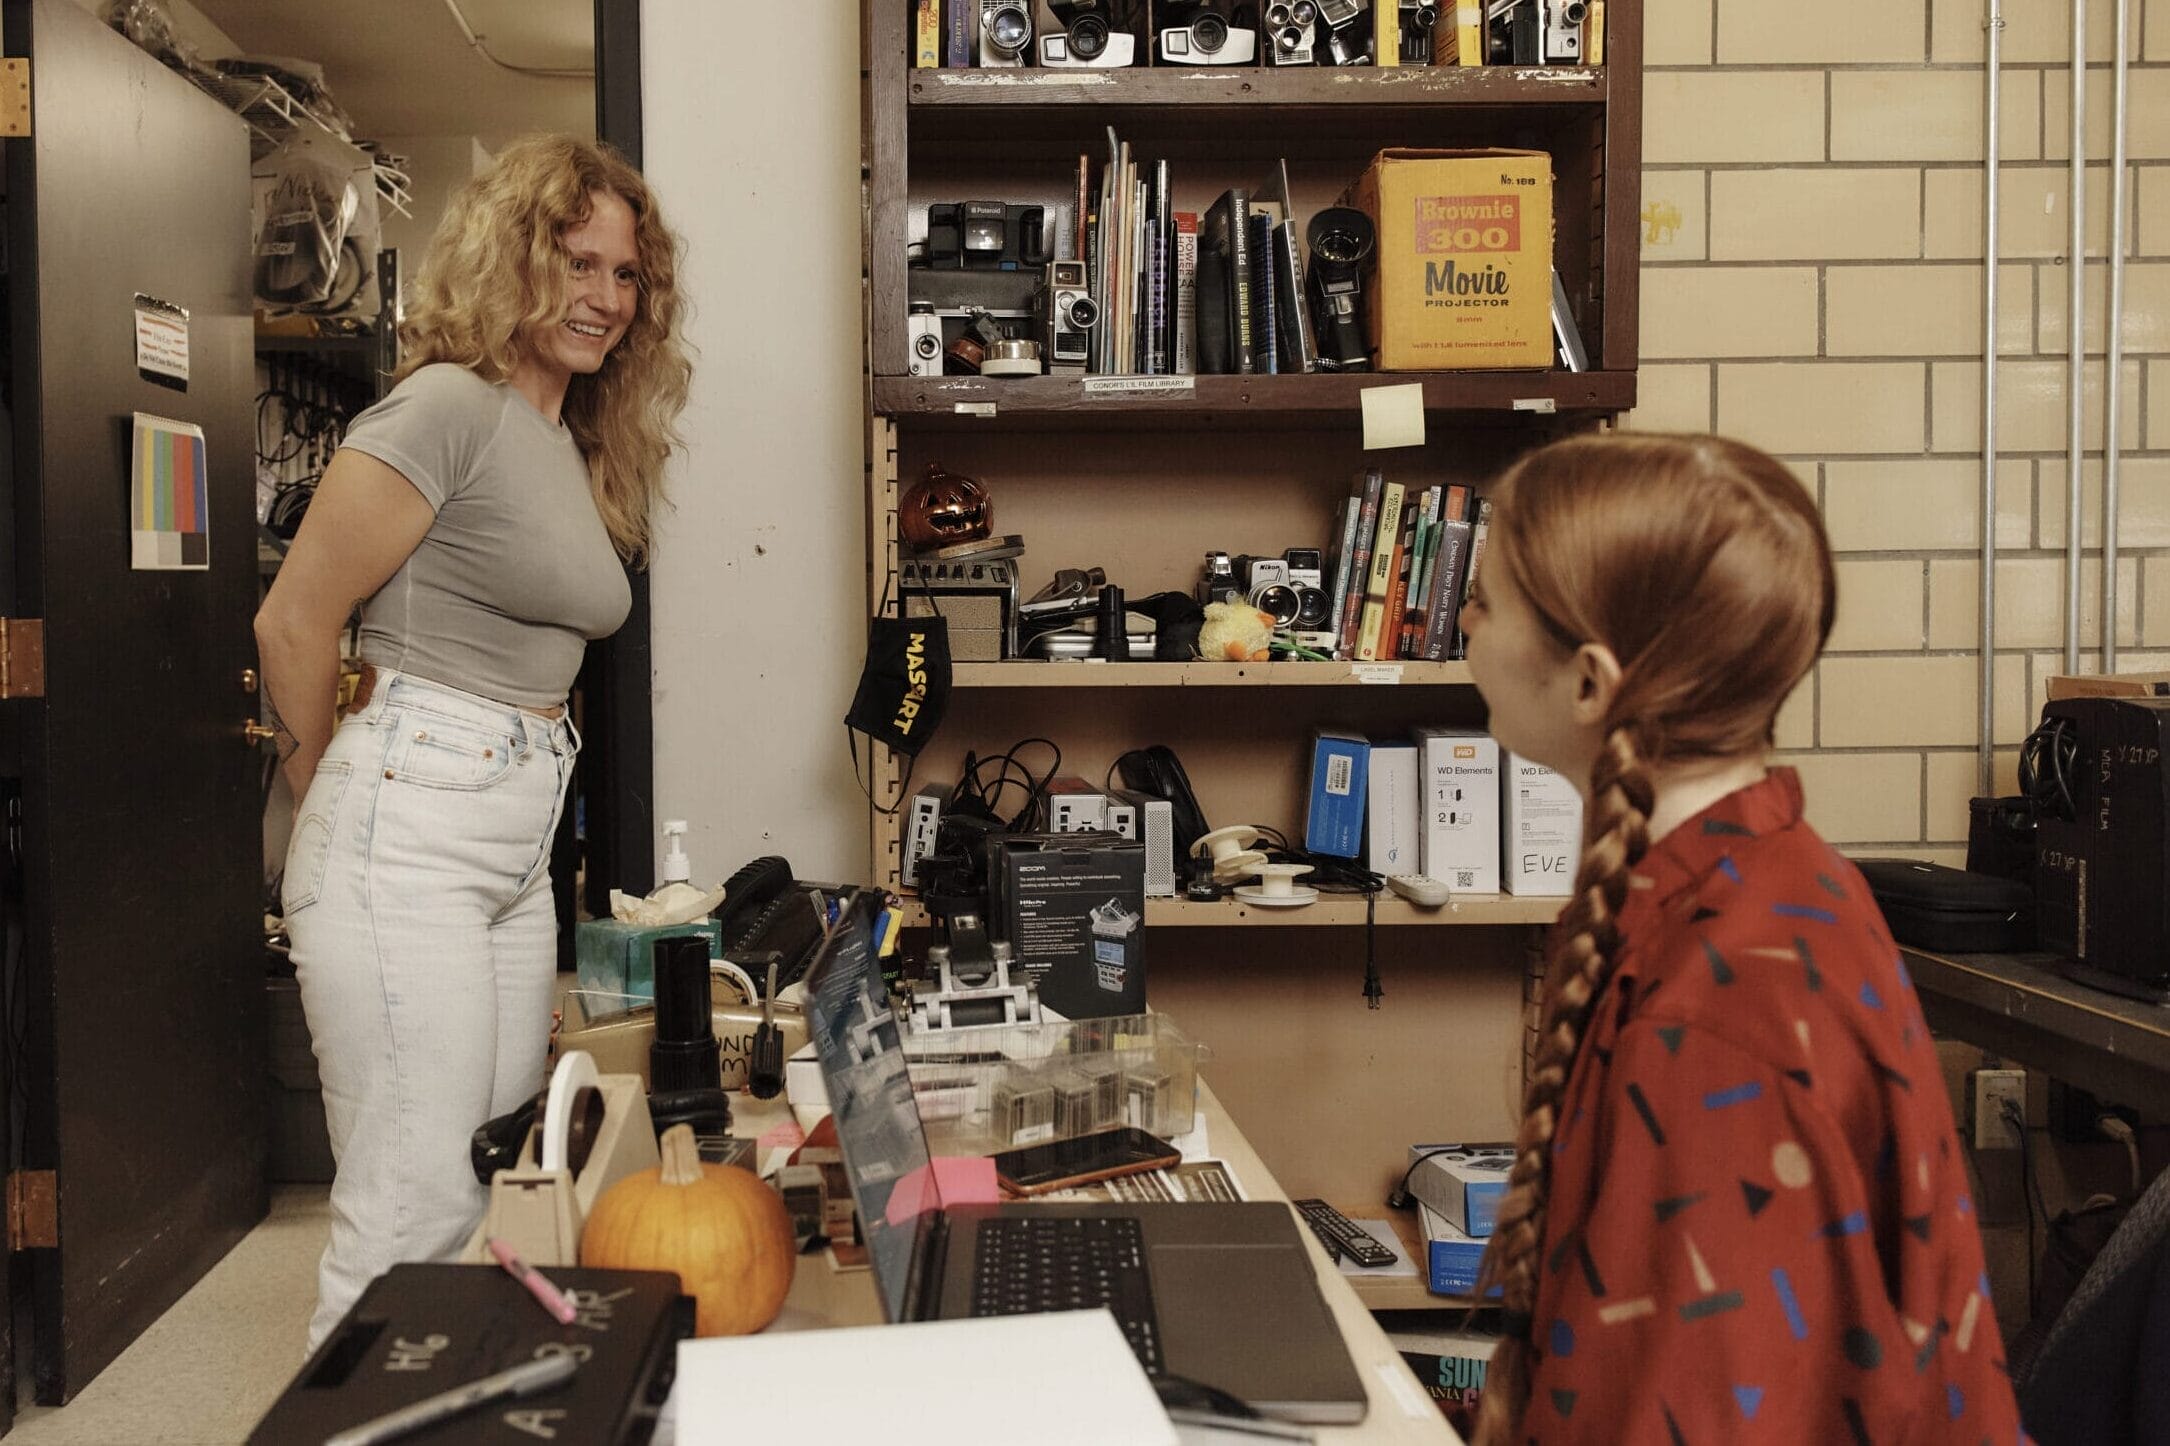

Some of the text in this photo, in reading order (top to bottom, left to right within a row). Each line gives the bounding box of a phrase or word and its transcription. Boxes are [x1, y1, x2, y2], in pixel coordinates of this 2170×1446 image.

[1422, 200, 1514, 222] Brownie
[1235, 199, 1246, 265] Independent Ed
[1426, 227, 1509, 250] 300
[1185, 236, 1195, 276] POWER
[1154, 237, 1168, 329] FEEDBACK
[1425, 260, 1509, 296] Movie
[1239, 282, 1250, 346] EDWARD BURNS
[1425, 299, 1509, 308] PROJECTOR
[1392, 581, 1406, 622] KEY GRIP
[1455, 748, 1473, 756] WD
[1437, 766, 1493, 775] WD Elements
[1521, 767, 1536, 775] WD
[1438, 813, 1446, 823] 2
[2100, 797, 2110, 830] FILM
[1523, 854, 1567, 873] EVE
[1439, 1356, 1487, 1389] SUN
[1426, 1385, 1461, 1400] ANIA
